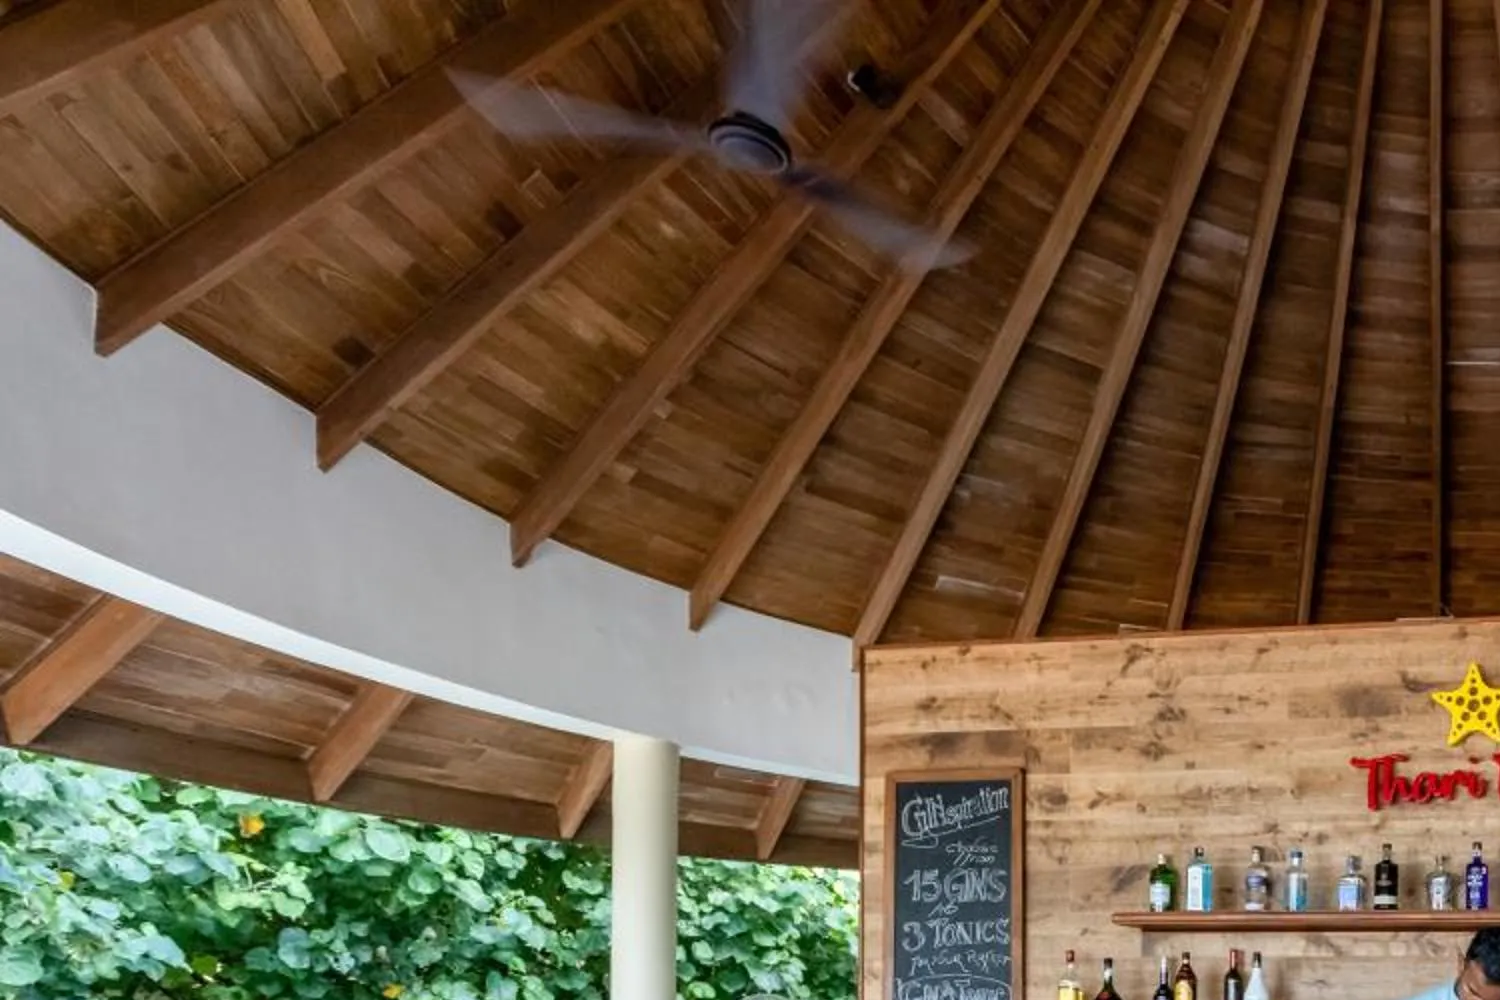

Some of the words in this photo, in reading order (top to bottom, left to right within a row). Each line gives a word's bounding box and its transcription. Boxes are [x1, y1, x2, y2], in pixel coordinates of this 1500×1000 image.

[903, 868, 942, 902] 15
[943, 866, 1008, 902] GINS
[902, 921, 926, 952] 3
